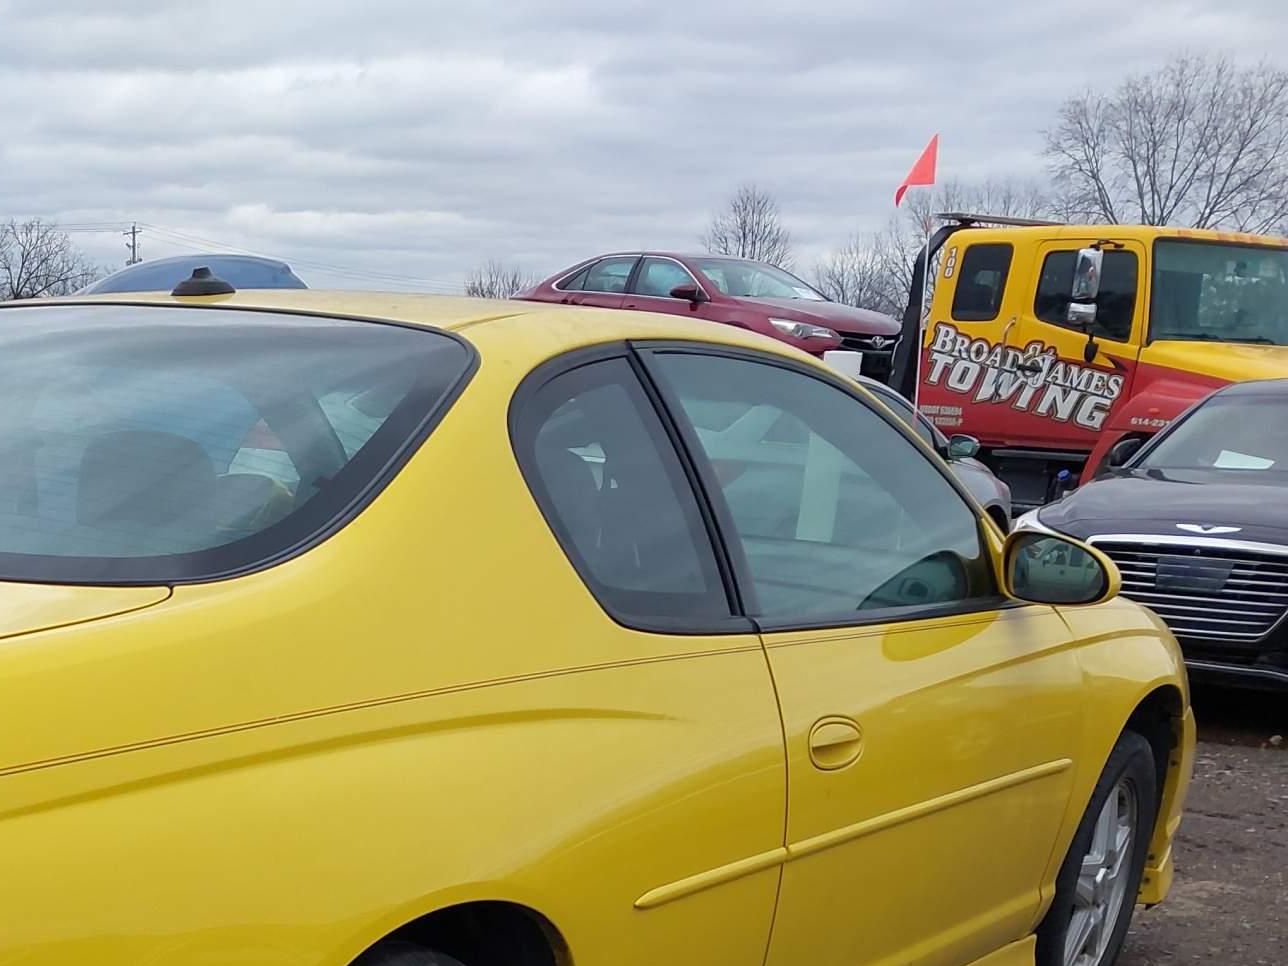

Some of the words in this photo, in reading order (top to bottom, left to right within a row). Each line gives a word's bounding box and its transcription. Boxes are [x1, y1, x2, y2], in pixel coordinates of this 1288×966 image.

[944, 247, 957, 278] 100
[926, 353, 1114, 431] TOWING
[931, 325, 1025, 372] BROAD
[1028, 354, 1125, 399] JAMES
